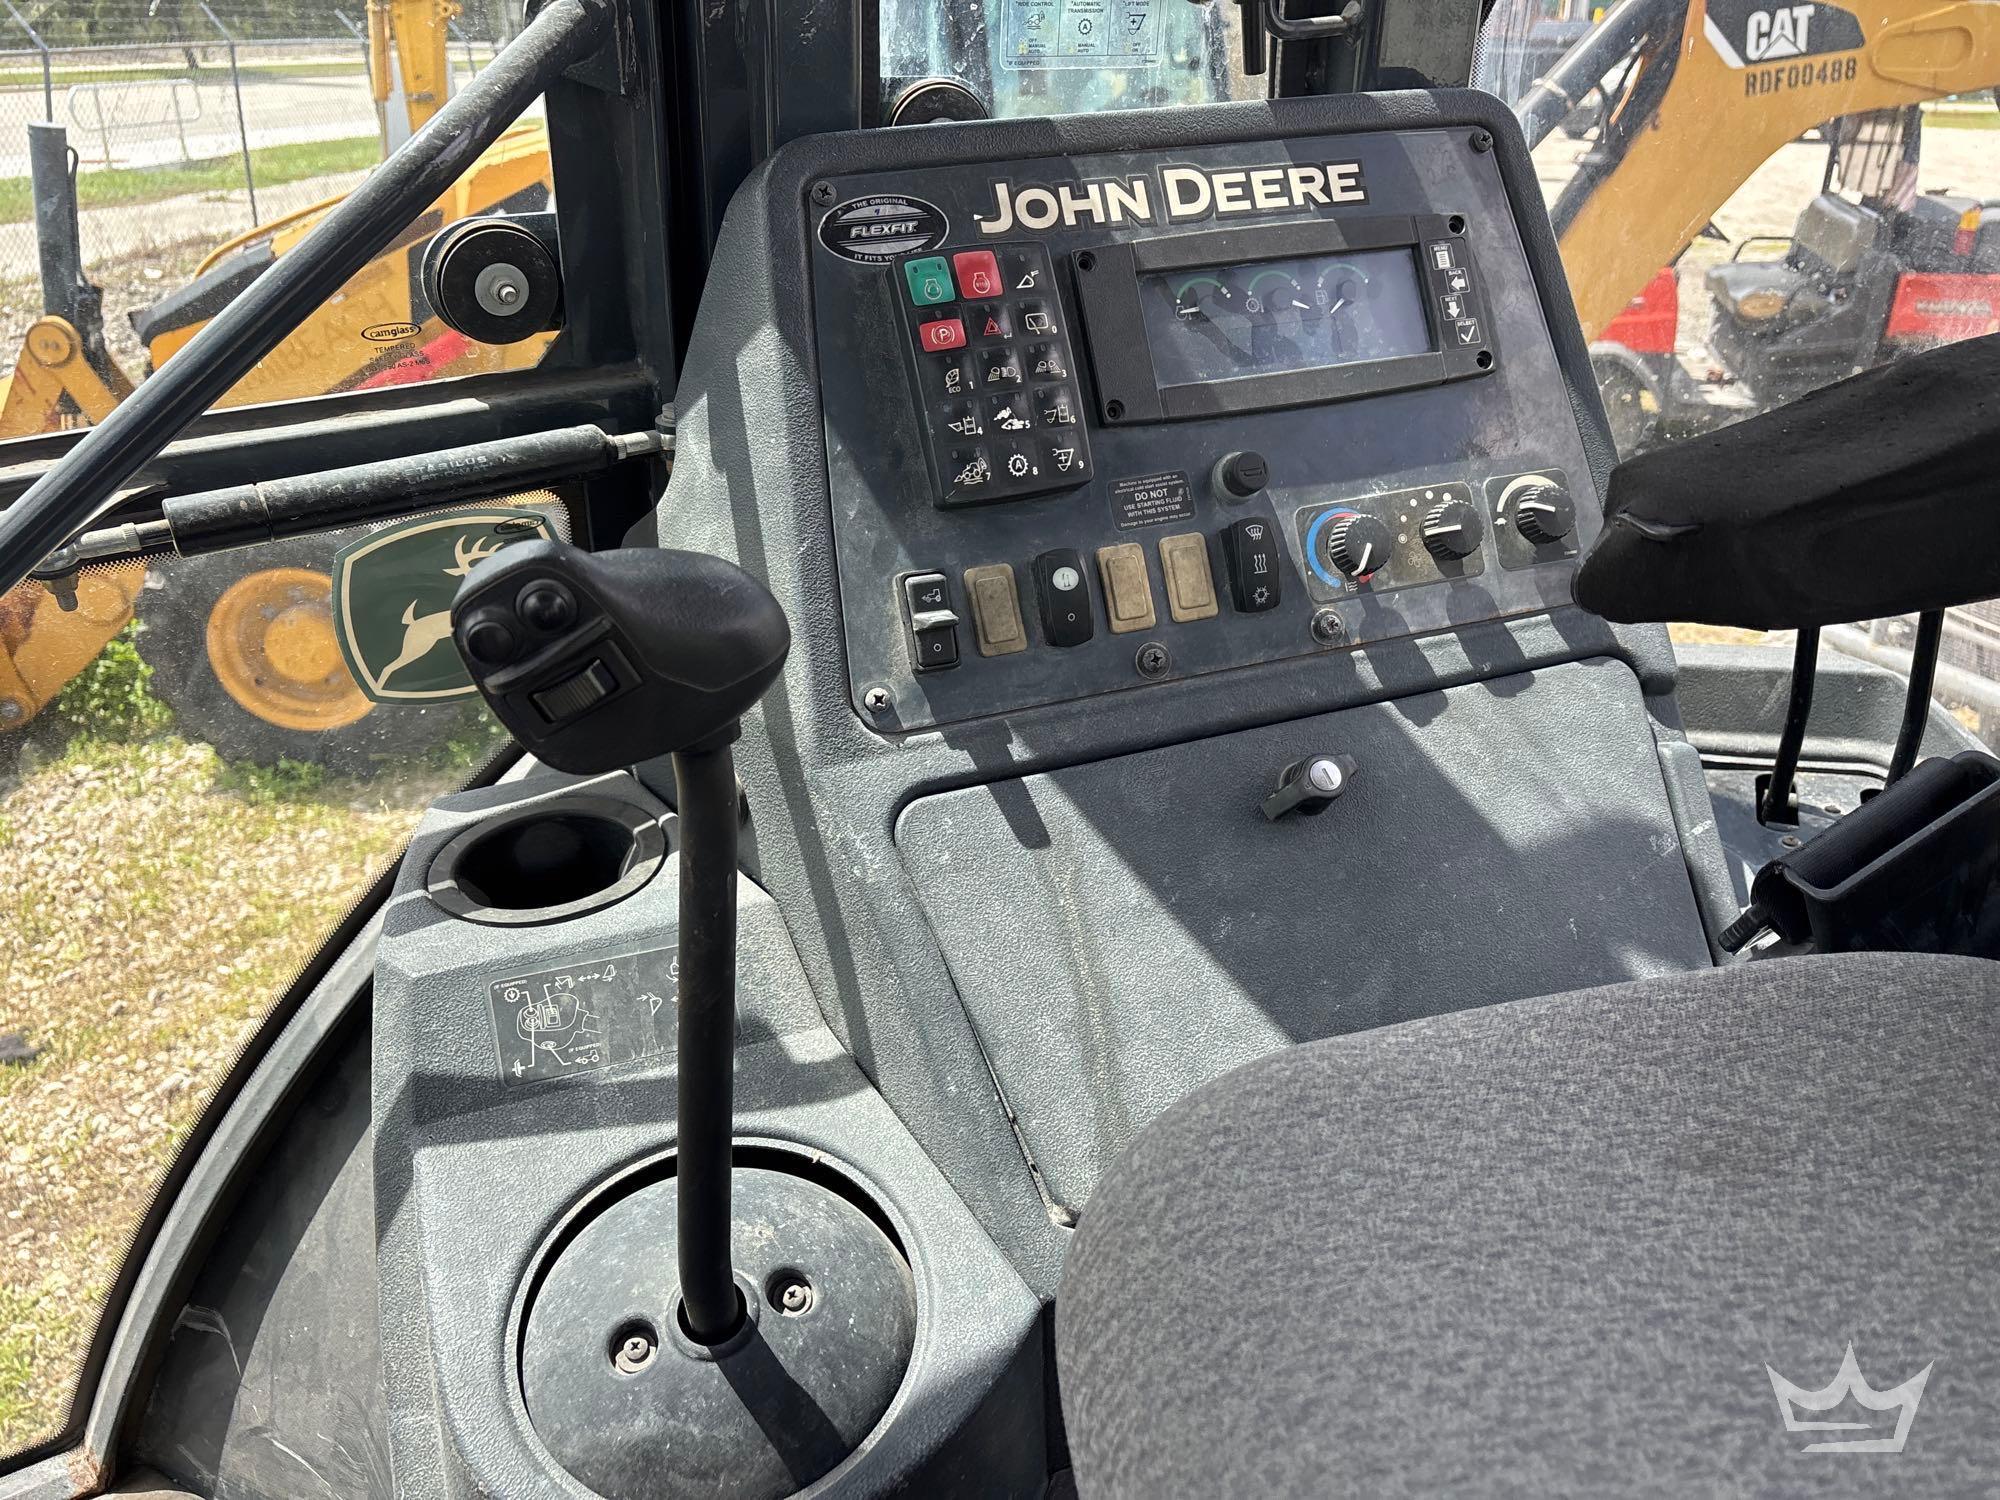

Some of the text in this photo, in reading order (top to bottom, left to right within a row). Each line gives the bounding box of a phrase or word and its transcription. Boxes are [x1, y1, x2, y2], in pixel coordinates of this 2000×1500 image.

[1746, 4, 1815, 60] CAT
[852, 197, 909, 209] THE ORIGINAL
[980, 164, 1365, 234] JOHN DEERE
[864, 254, 883, 262] FITS
[1456, 319, 1475, 327] SELECT
[369, 325, 415, 338] camglass
[374, 342, 416, 354] TEMPERED
[1061, 369, 1067, 378] 3
[1016, 374, 1022, 383] 2
[948, 385, 962, 394] ECO
[968, 381, 974, 390] 1
[1070, 415, 1076, 424] 6
[1025, 420, 1031, 429] 5
[977, 426, 983, 435] 4
[1078, 460, 1085, 469] 9
[1032, 466, 1038, 475] 8
[985, 472, 991, 480] 7
[1134, 488, 1168, 502] DO NOT
[1137, 500, 1165, 509] STARTING
[1165, 496, 1183, 504] FLUID
[1127, 510, 1143, 518] WITH
